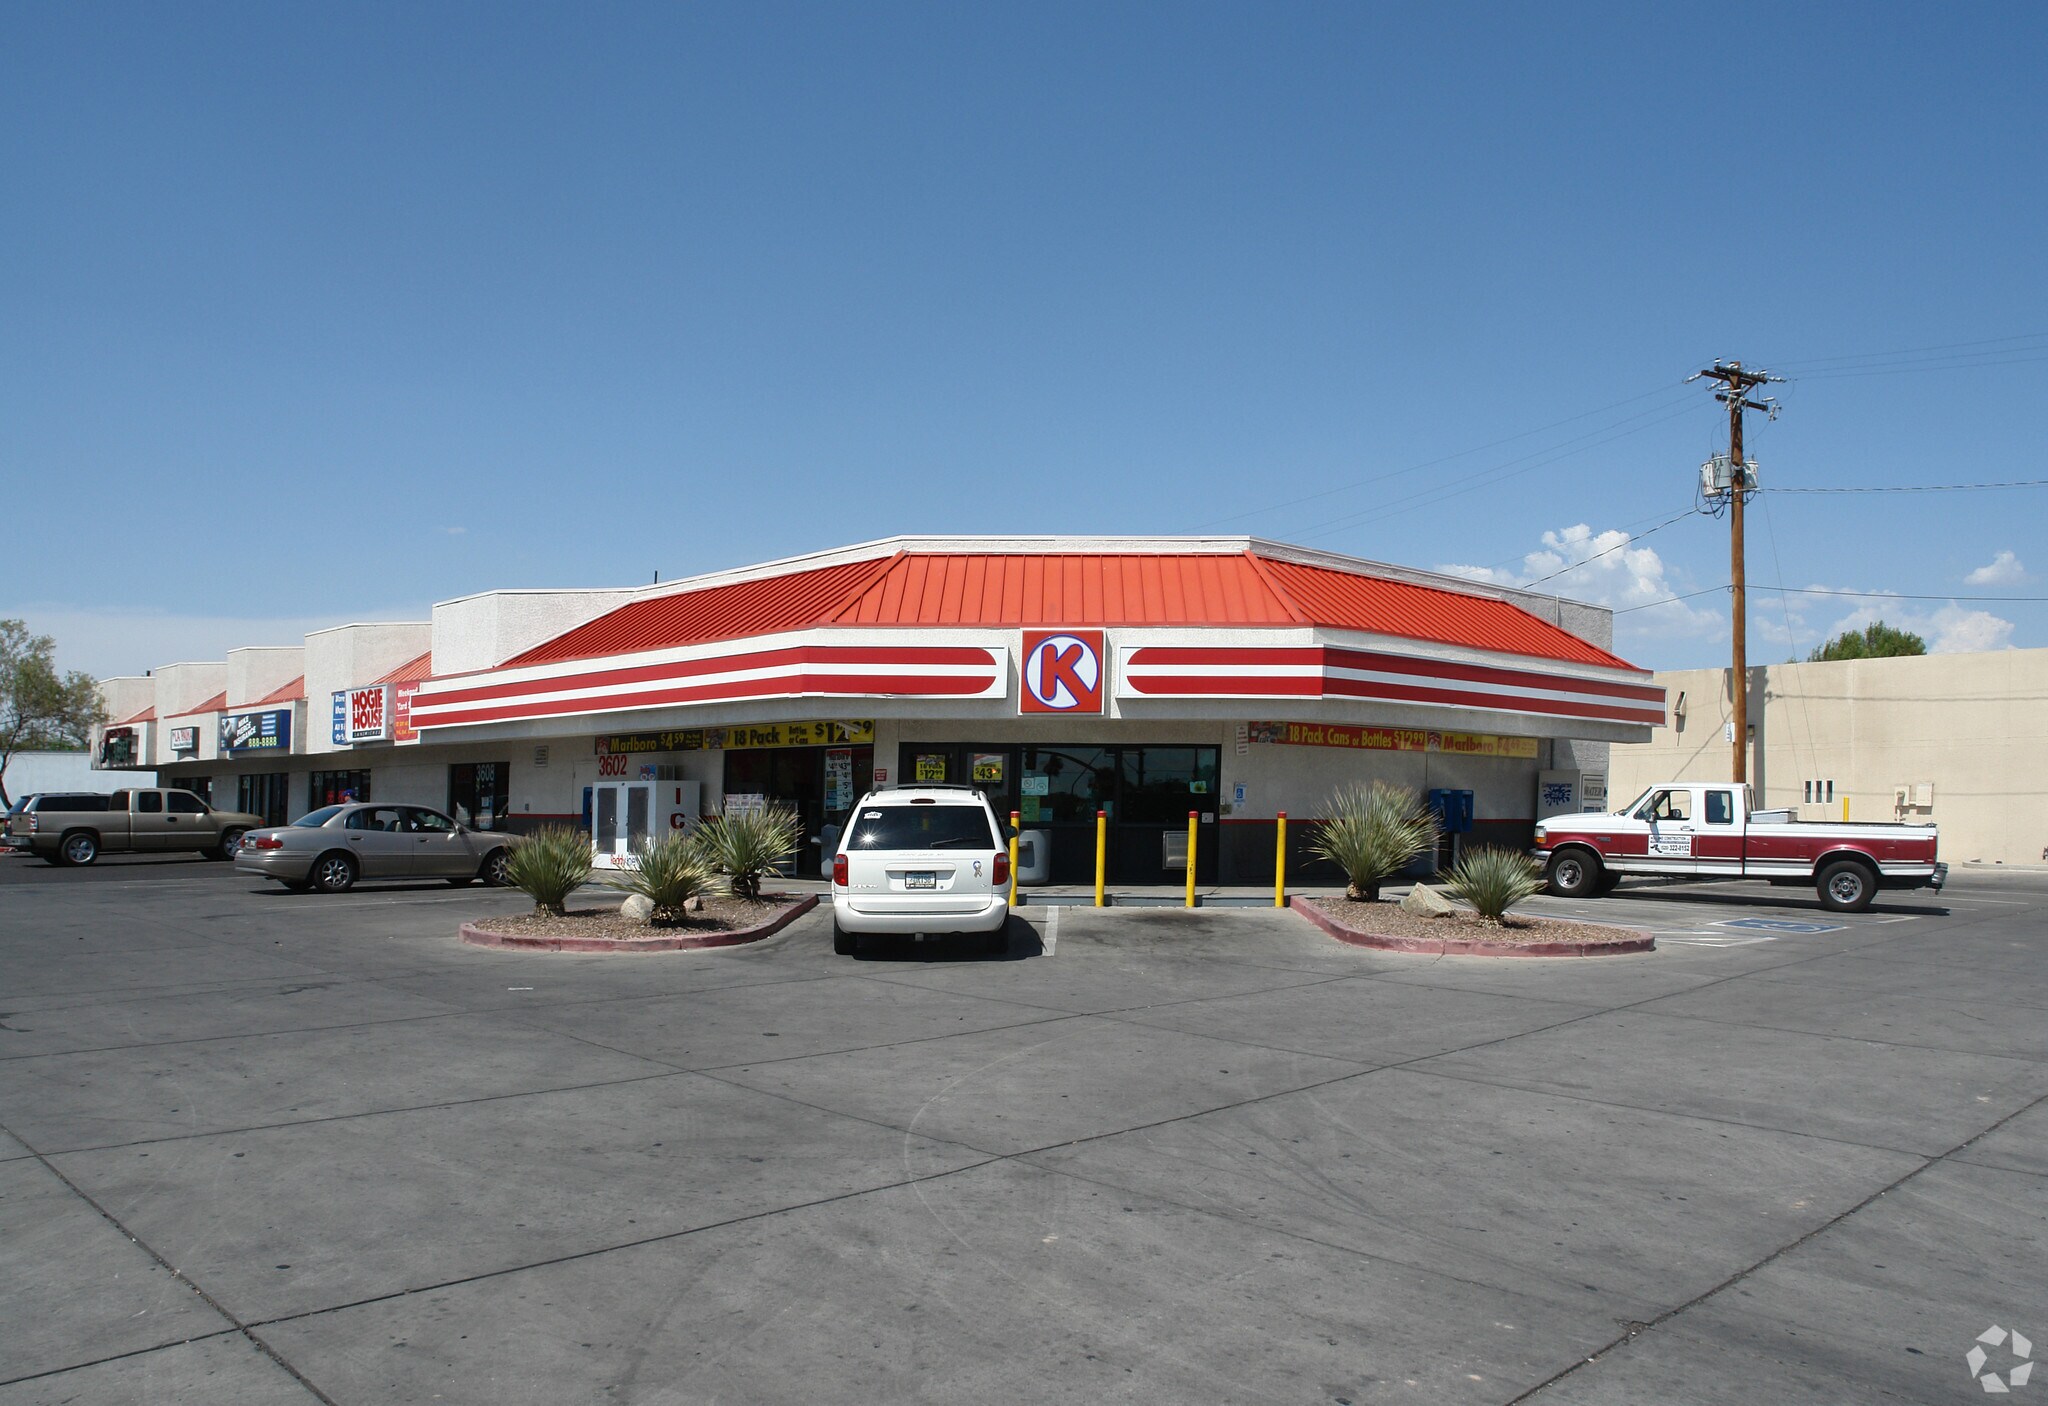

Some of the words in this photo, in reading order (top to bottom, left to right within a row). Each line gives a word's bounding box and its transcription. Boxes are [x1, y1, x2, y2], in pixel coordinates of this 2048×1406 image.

[351, 688, 382, 711] HOGIE
[352, 709, 383, 730] HOUSE
[610, 737, 657, 752] Marlboro
[734, 729, 747, 746] 18
[750, 727, 780, 745] Pack
[1289, 726, 1299, 742] 18
[1302, 727, 1324, 744] Pack
[1328, 728, 1350, 746] Cans
[1352, 738, 1359, 746] or
[1361, 731, 1392, 748] Bottles
[1443, 736, 1493, 752] Marlboro
[476, 765, 495, 781] 3608
[598, 755, 627, 776] 3602
